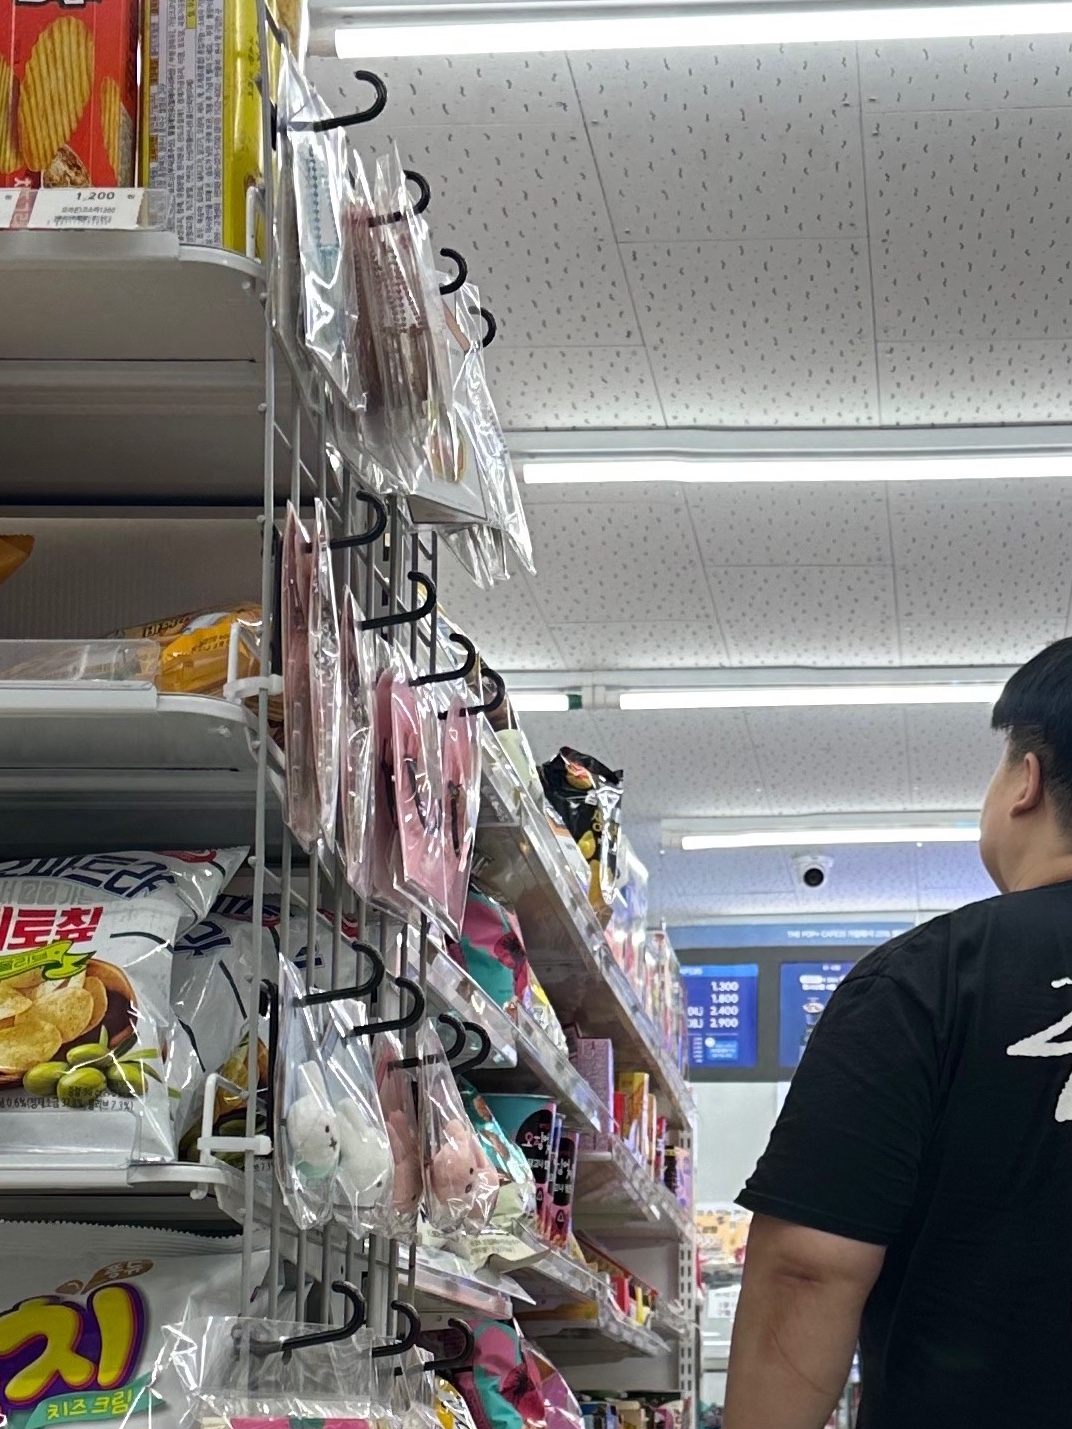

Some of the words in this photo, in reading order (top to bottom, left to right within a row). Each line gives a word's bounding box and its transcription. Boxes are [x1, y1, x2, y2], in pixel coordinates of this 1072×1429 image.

[76, 191, 115, 201] 1,200
[48, 1399, 87, 1420] 치즈
[91, 1389, 133, 1415] 크림
